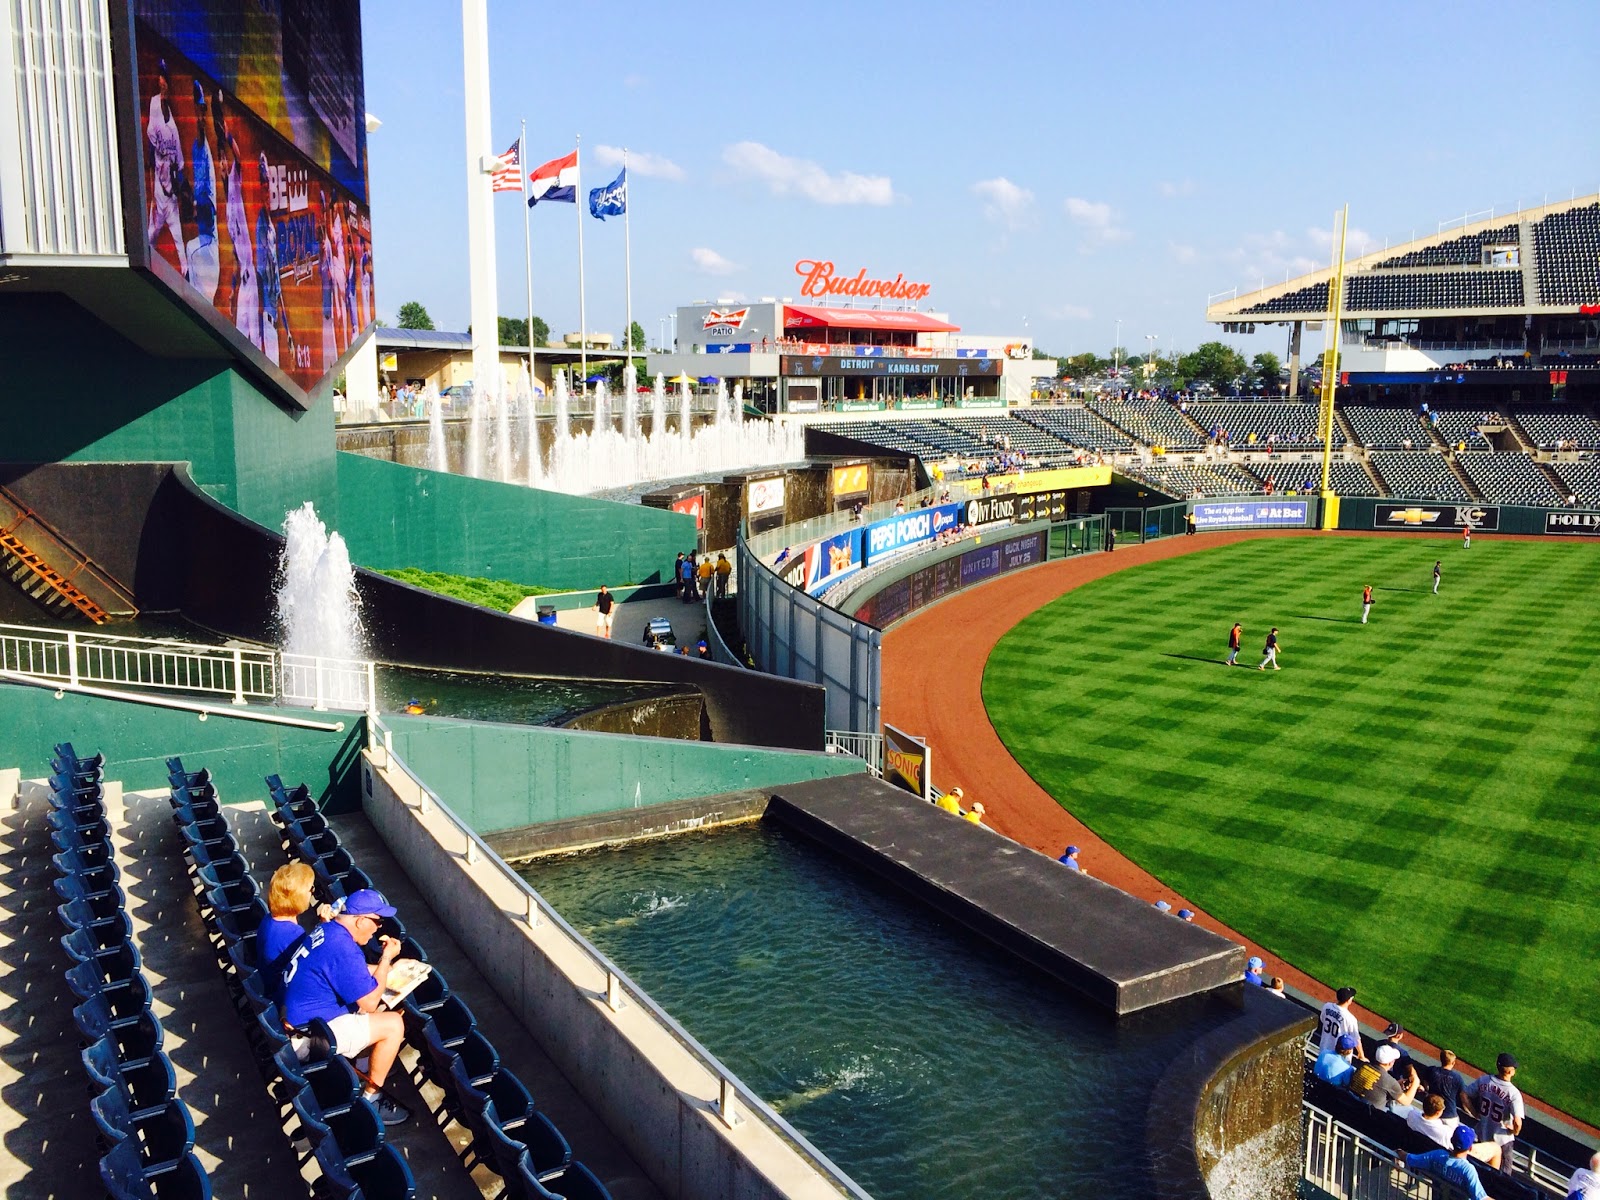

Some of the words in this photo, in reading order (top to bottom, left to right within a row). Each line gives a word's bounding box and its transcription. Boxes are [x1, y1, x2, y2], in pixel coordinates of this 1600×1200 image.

[269, 165, 288, 212] BE
[795, 259, 931, 300] Budweiser
[712, 327, 733, 336] PATIO
[840, 359, 875, 369] DETROIT
[888, 364, 920, 374] KANSAS
[921, 364, 940, 374] CITY
[941, 512, 954, 526] pepsi
[1203, 507, 1215, 515] The
[1222, 506, 1235, 515] App
[1268, 507, 1283, 519] At
[1282, 507, 1303, 518] Bat
[1196, 516, 1208, 524] Live
[1208, 514, 1228, 525] Royals
[1227, 514, 1254, 522] Baseball
[870, 524, 896, 553] PEPSI
[896, 513, 931, 543] PORCH
[1004, 541, 1020, 555] BUCK
[1020, 536, 1038, 551] NIGHT
[963, 557, 991, 575] UNITED
[1009, 554, 1023, 568] JULY
[1023, 551, 1031, 563] 25
[888, 749, 920, 781] SONIC
[1323, 1017, 1340, 1039] 30
[1480, 1097, 1506, 1123] 35
